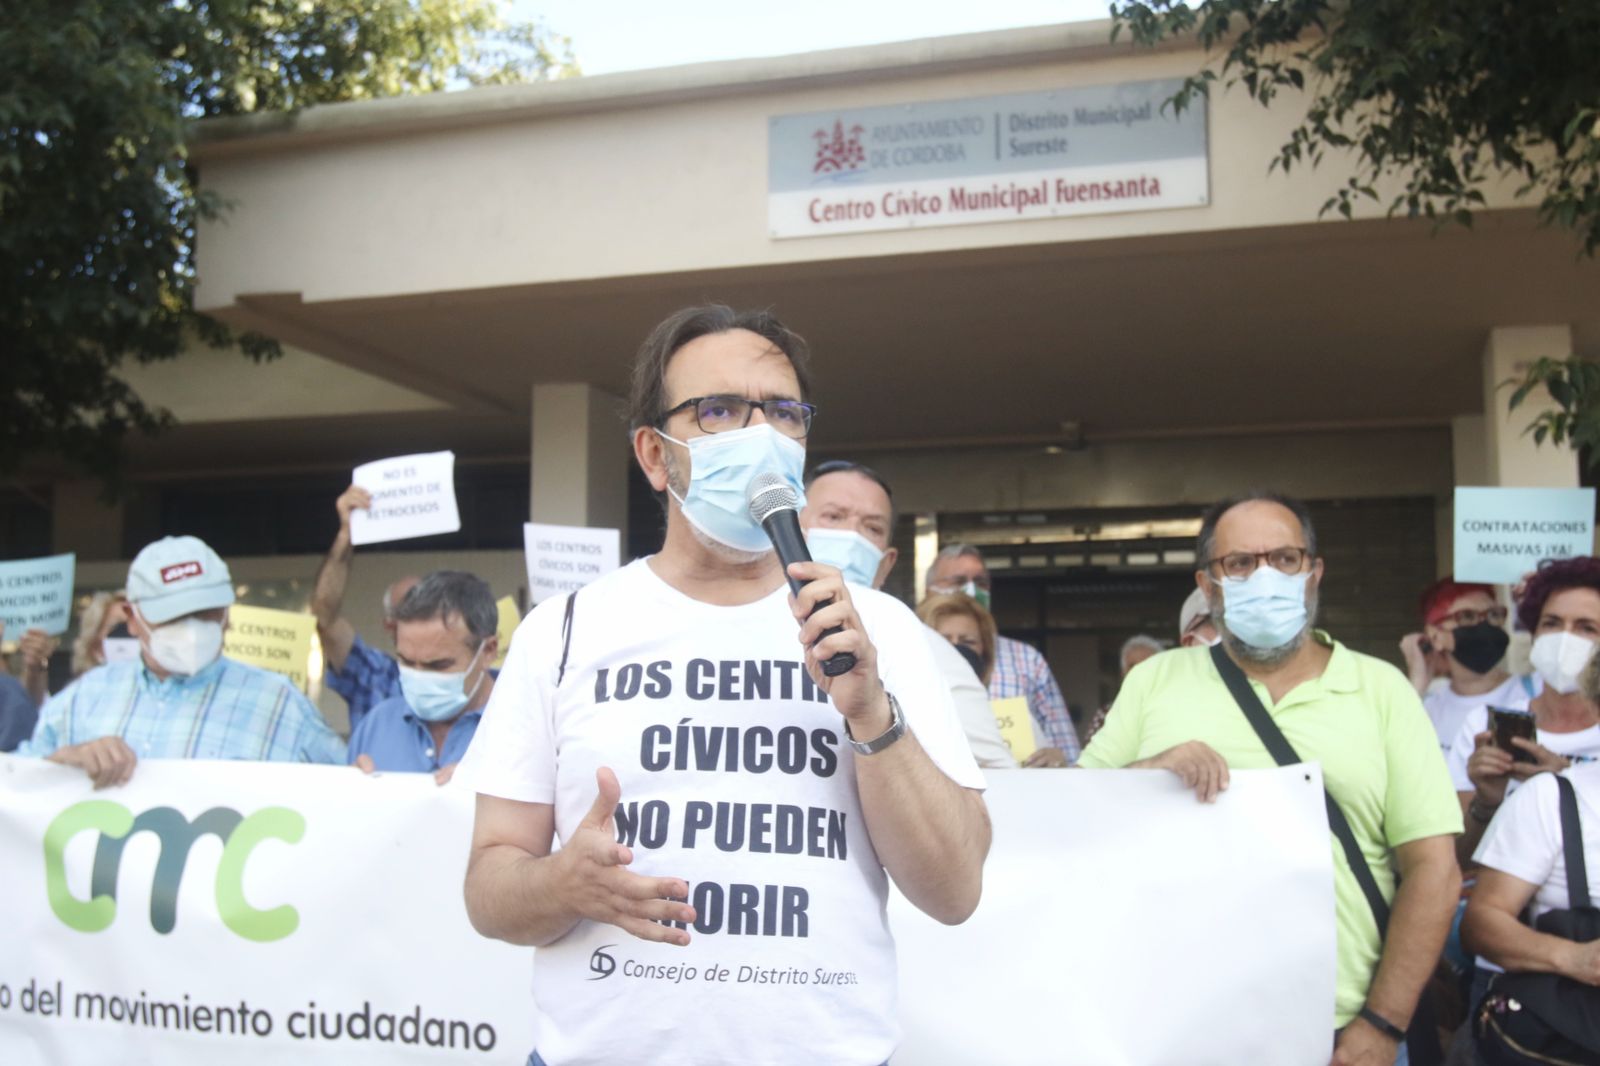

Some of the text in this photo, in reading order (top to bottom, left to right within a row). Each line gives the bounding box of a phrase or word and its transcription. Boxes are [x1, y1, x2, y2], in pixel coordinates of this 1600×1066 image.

[1009, 102, 1152, 133] Distrito Municipal
[871, 116, 984, 143] AYUNTAMIENTO
[870, 149, 888, 168] DE
[1009, 137, 1068, 157] Sureste
[809, 174, 1161, 223] Centro Cívico Municipal Fuensanta
[1462, 520, 1587, 534] CONTRATACIONES
[555, 541, 603, 555] CENTROS
[1477, 542, 1541, 555] MASIVAS
[577, 561, 600, 574] SON
[238, 622, 297, 642] CENTROS
[266, 646, 292, 660] SON
[595, 660, 672, 703] LOS
[640, 717, 839, 778] CÍVICOS
[615, 800, 848, 861] NO PUEDEN
[622, 959, 697, 984] Consejo
[704, 963, 730, 982] de
[737, 965, 808, 985] Distrito
[21, 978, 62, 1017] del
[75, 990, 273, 1037] movimiento
[287, 1002, 497, 1052] ciudadano
